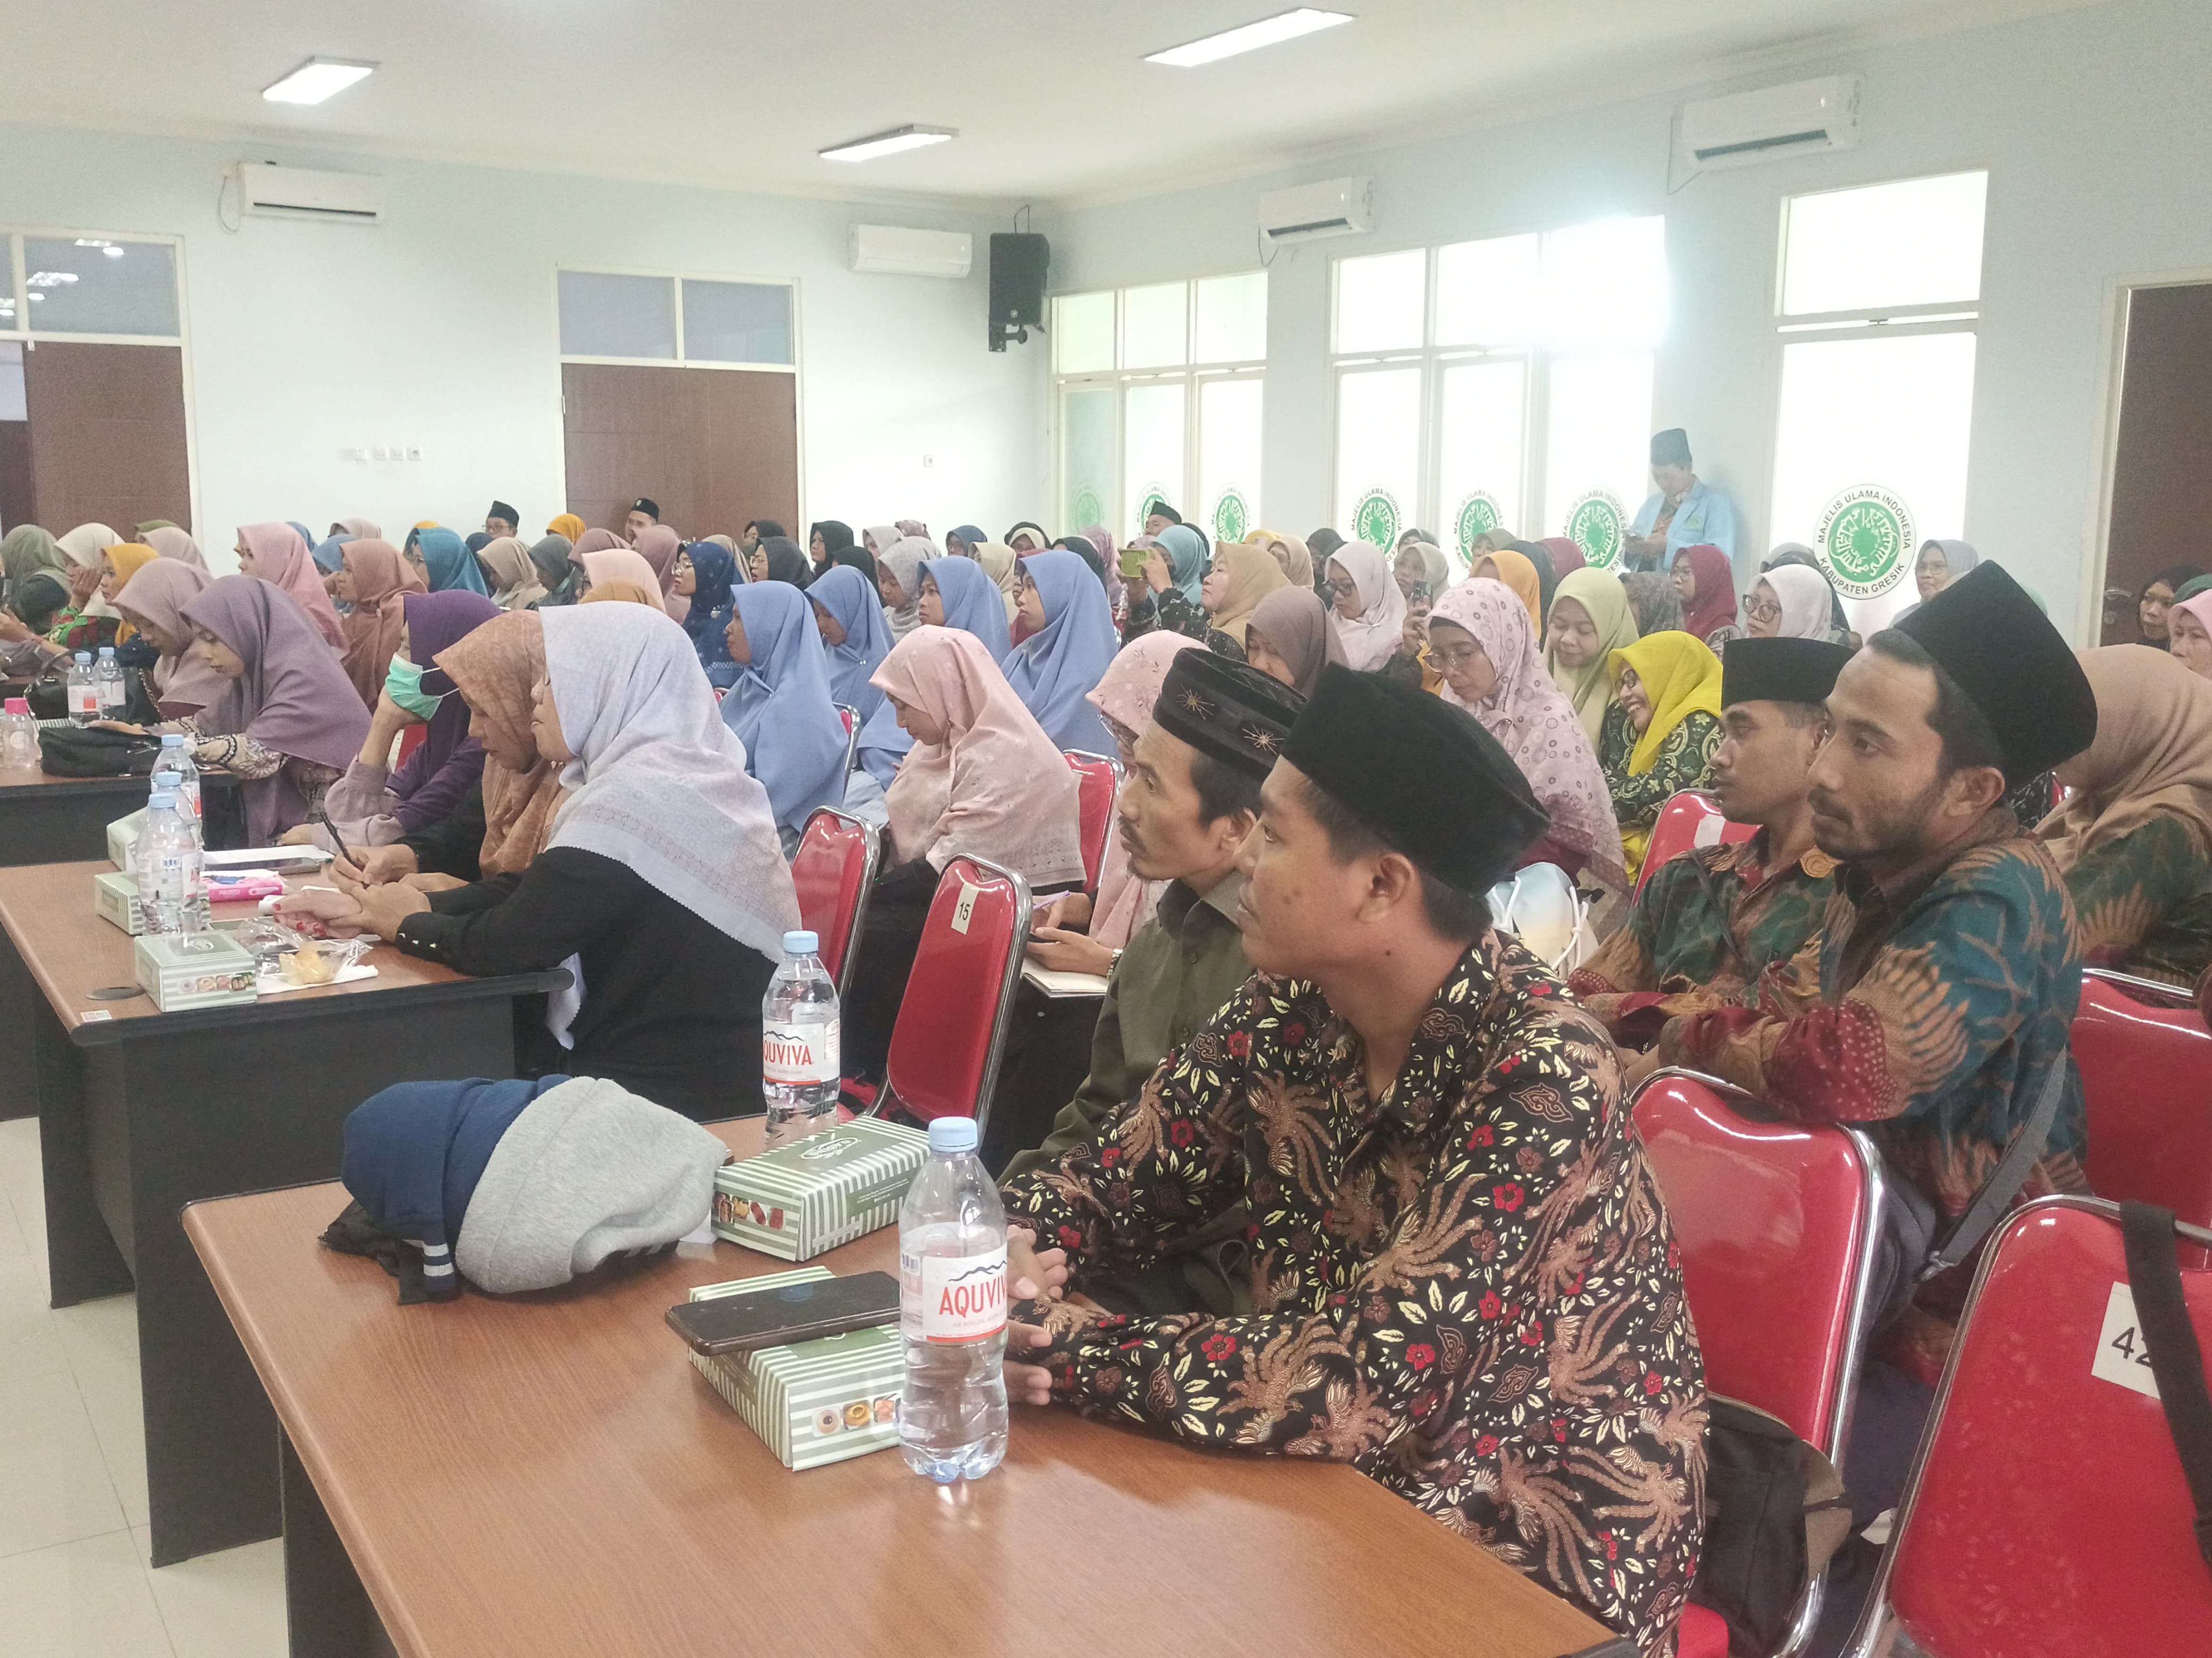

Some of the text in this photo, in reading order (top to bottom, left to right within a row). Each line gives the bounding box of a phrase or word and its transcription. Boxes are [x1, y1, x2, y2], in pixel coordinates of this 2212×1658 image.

[1364, 487, 1383, 499] ULAMA
[1579, 490, 1603, 502] ULAMA
[1818, 500, 1843, 543] MAJELIS
[1845, 490, 1880, 503] ULAMA
[1882, 494, 1911, 549] INDONESIA
[1820, 558, 1905, 594] KABUPATEN GRESIK
[959, 901, 970, 921] 15
[764, 1039, 812, 1066] QUVIVA
[939, 1271, 1007, 1318] AQUVIV
